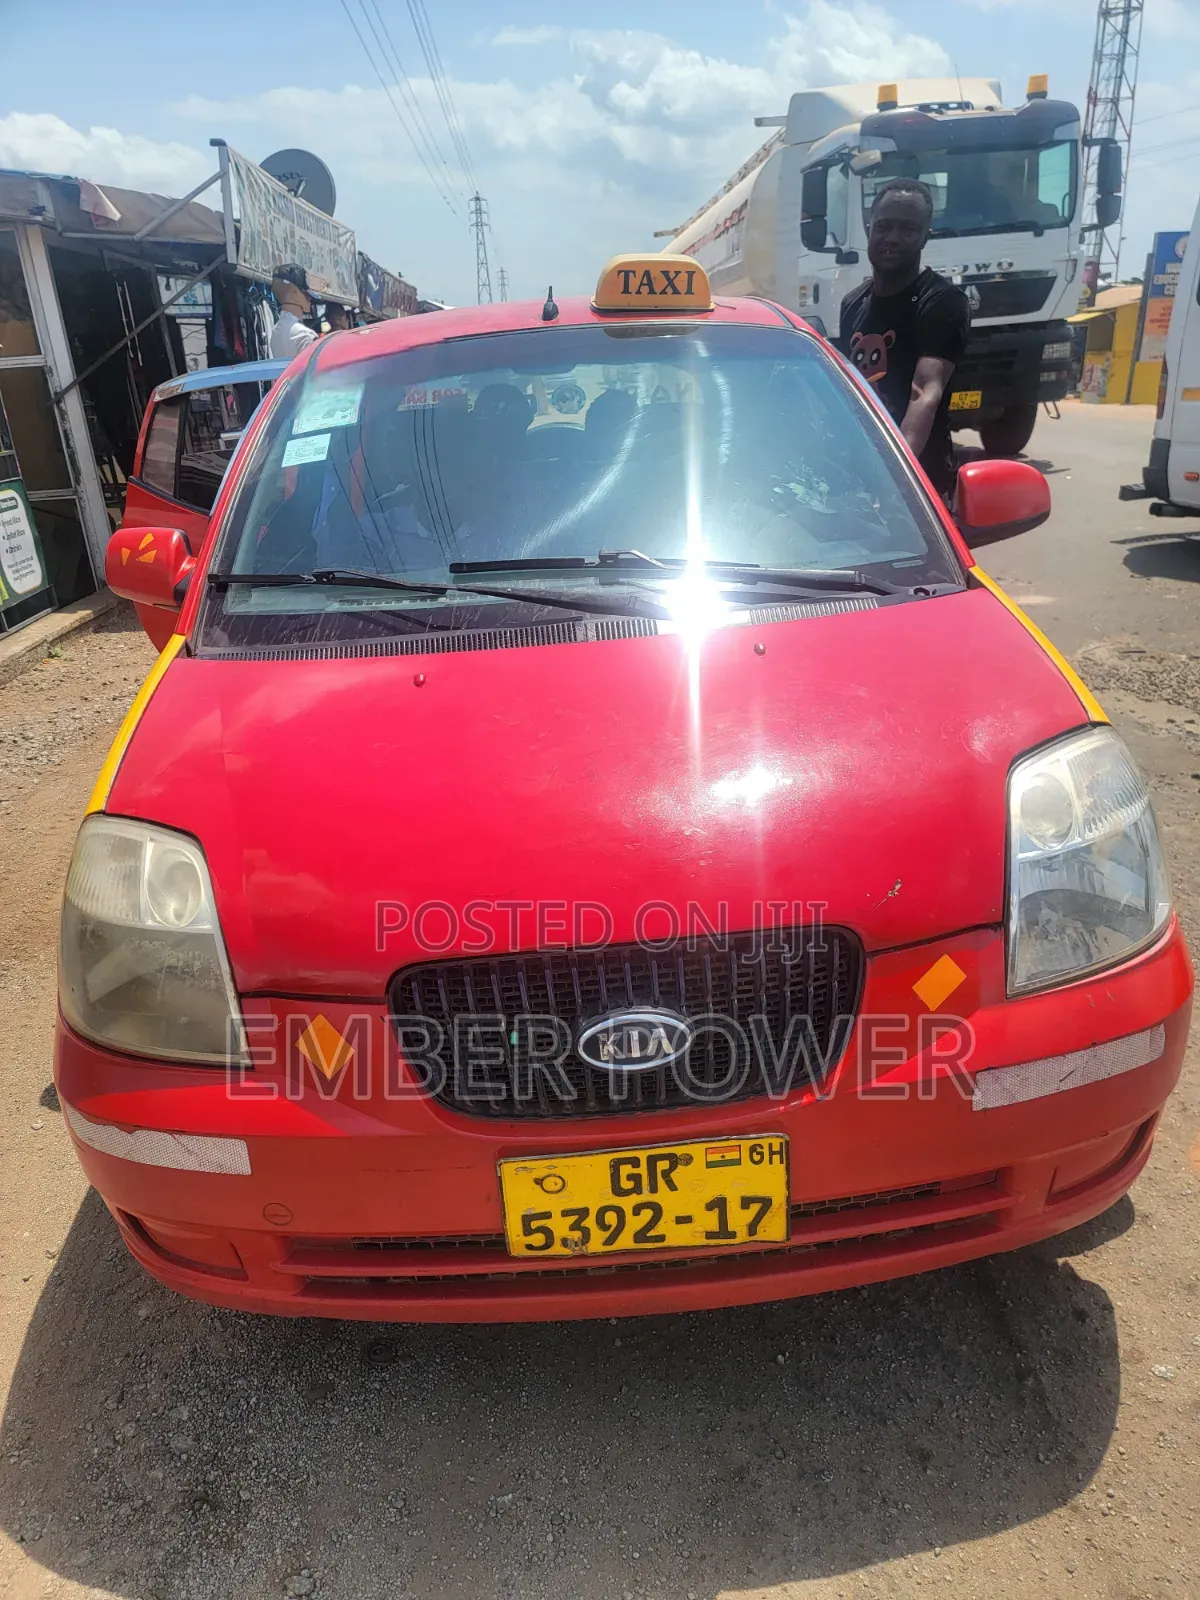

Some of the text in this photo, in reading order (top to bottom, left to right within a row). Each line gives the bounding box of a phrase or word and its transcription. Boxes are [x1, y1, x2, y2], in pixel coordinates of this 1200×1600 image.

[617, 269, 697, 295] TAXI
[597, 1027, 674, 1061] KIA
[748, 1142, 785, 1166] GH
[609, 1152, 679, 1198] GR
[520, 1195, 773, 1252] 5392-17
